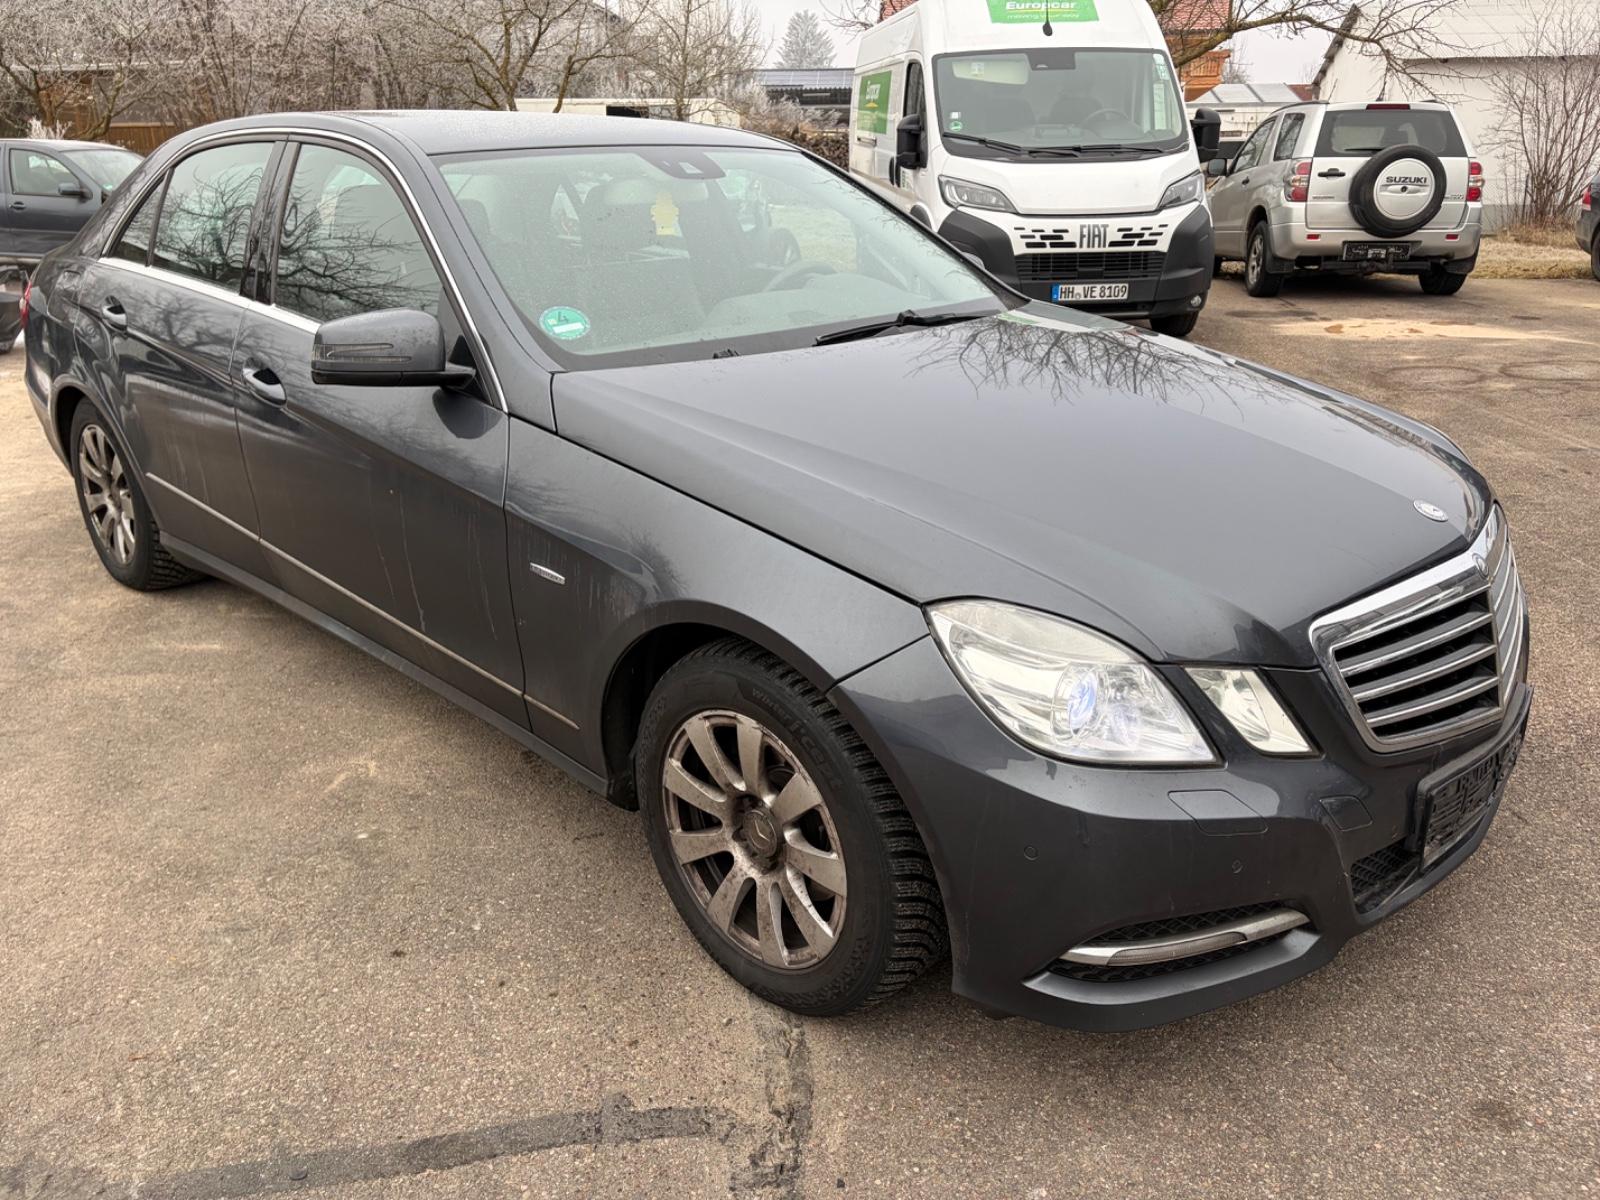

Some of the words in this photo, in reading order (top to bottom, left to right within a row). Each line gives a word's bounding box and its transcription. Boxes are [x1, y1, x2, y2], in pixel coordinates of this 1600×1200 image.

[1006, 1, 1077, 11] Europcar
[1386, 176, 1428, 184] SUZUKI
[1079, 224, 1109, 249] FIAT
[1060, 286, 1075, 299] HH
[1083, 286, 1097, 298] VE
[1099, 285, 1128, 298] 8109
